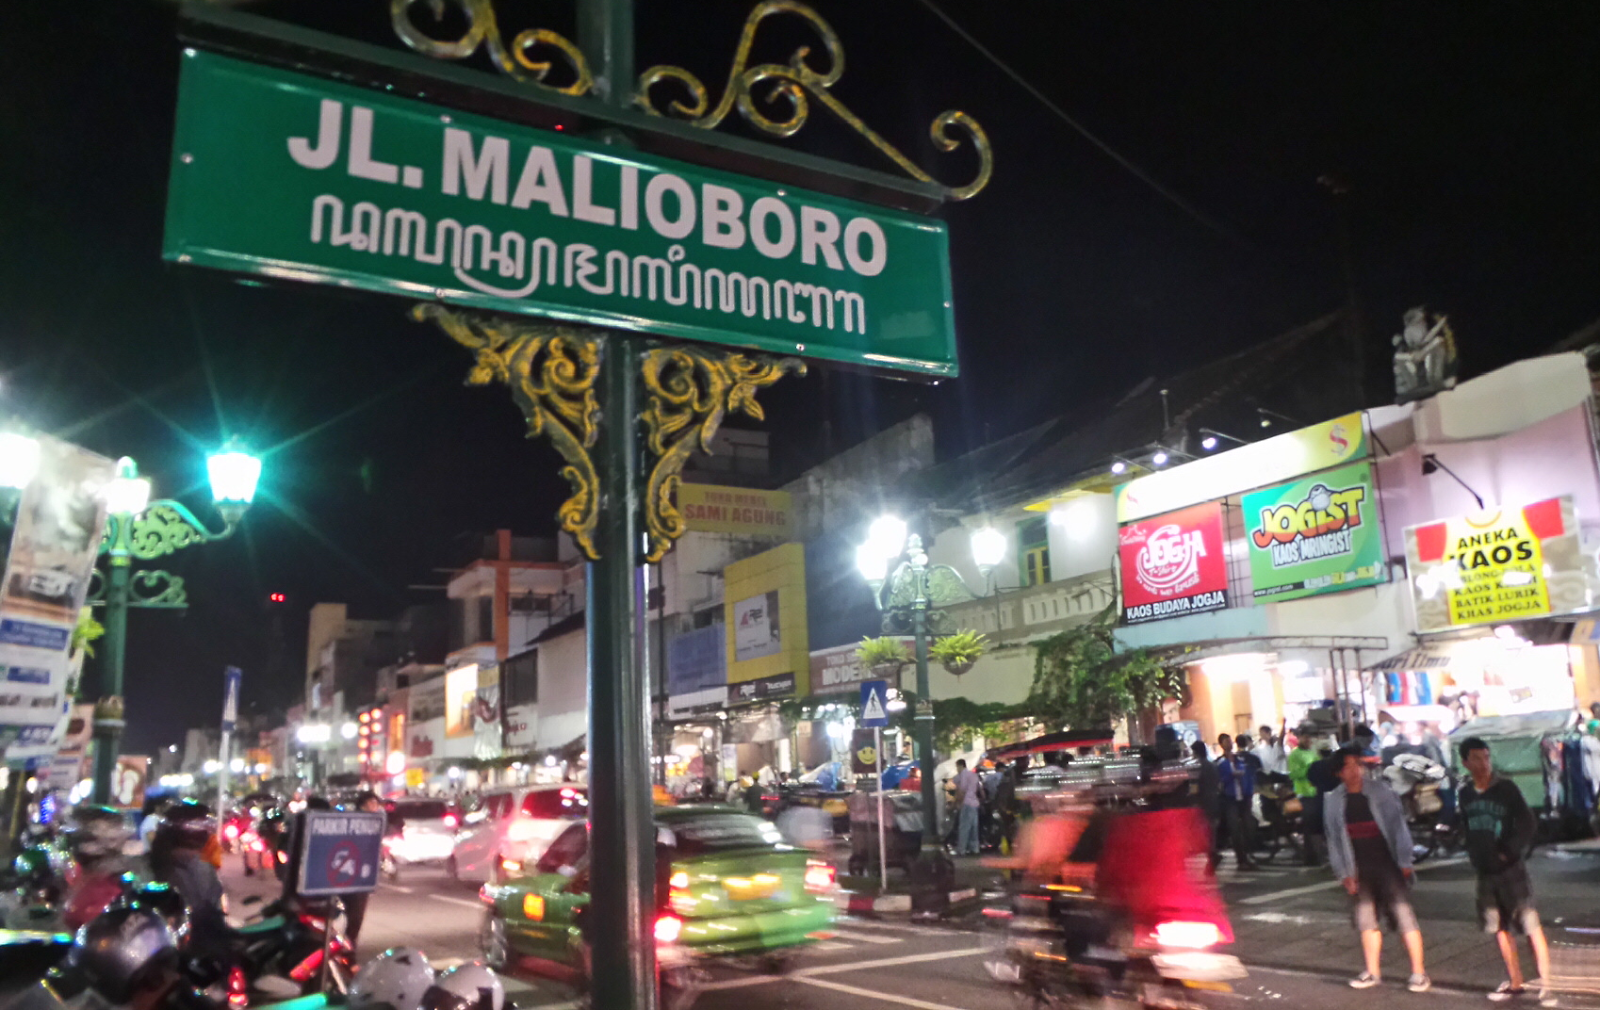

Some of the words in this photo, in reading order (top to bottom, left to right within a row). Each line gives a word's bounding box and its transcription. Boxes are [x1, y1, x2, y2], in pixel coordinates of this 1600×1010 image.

[287, 99, 424, 189] JL.
[441, 127, 888, 277] MALIOBORO
[685, 503, 728, 521] SAMI
[731, 507, 785, 525] AGUNG
[1253, 487, 1365, 548] JOGIST
[1458, 527, 1519, 549] ANEKA
[1449, 540, 1533, 571] KAOS
[1127, 605, 1152, 619] KAOS
[1153, 598, 1190, 614] BUDAYA
[1192, 591, 1225, 608] JOGJA
[1457, 605, 1493, 620] KHAS
[1497, 600, 1541, 614] JOGJA
